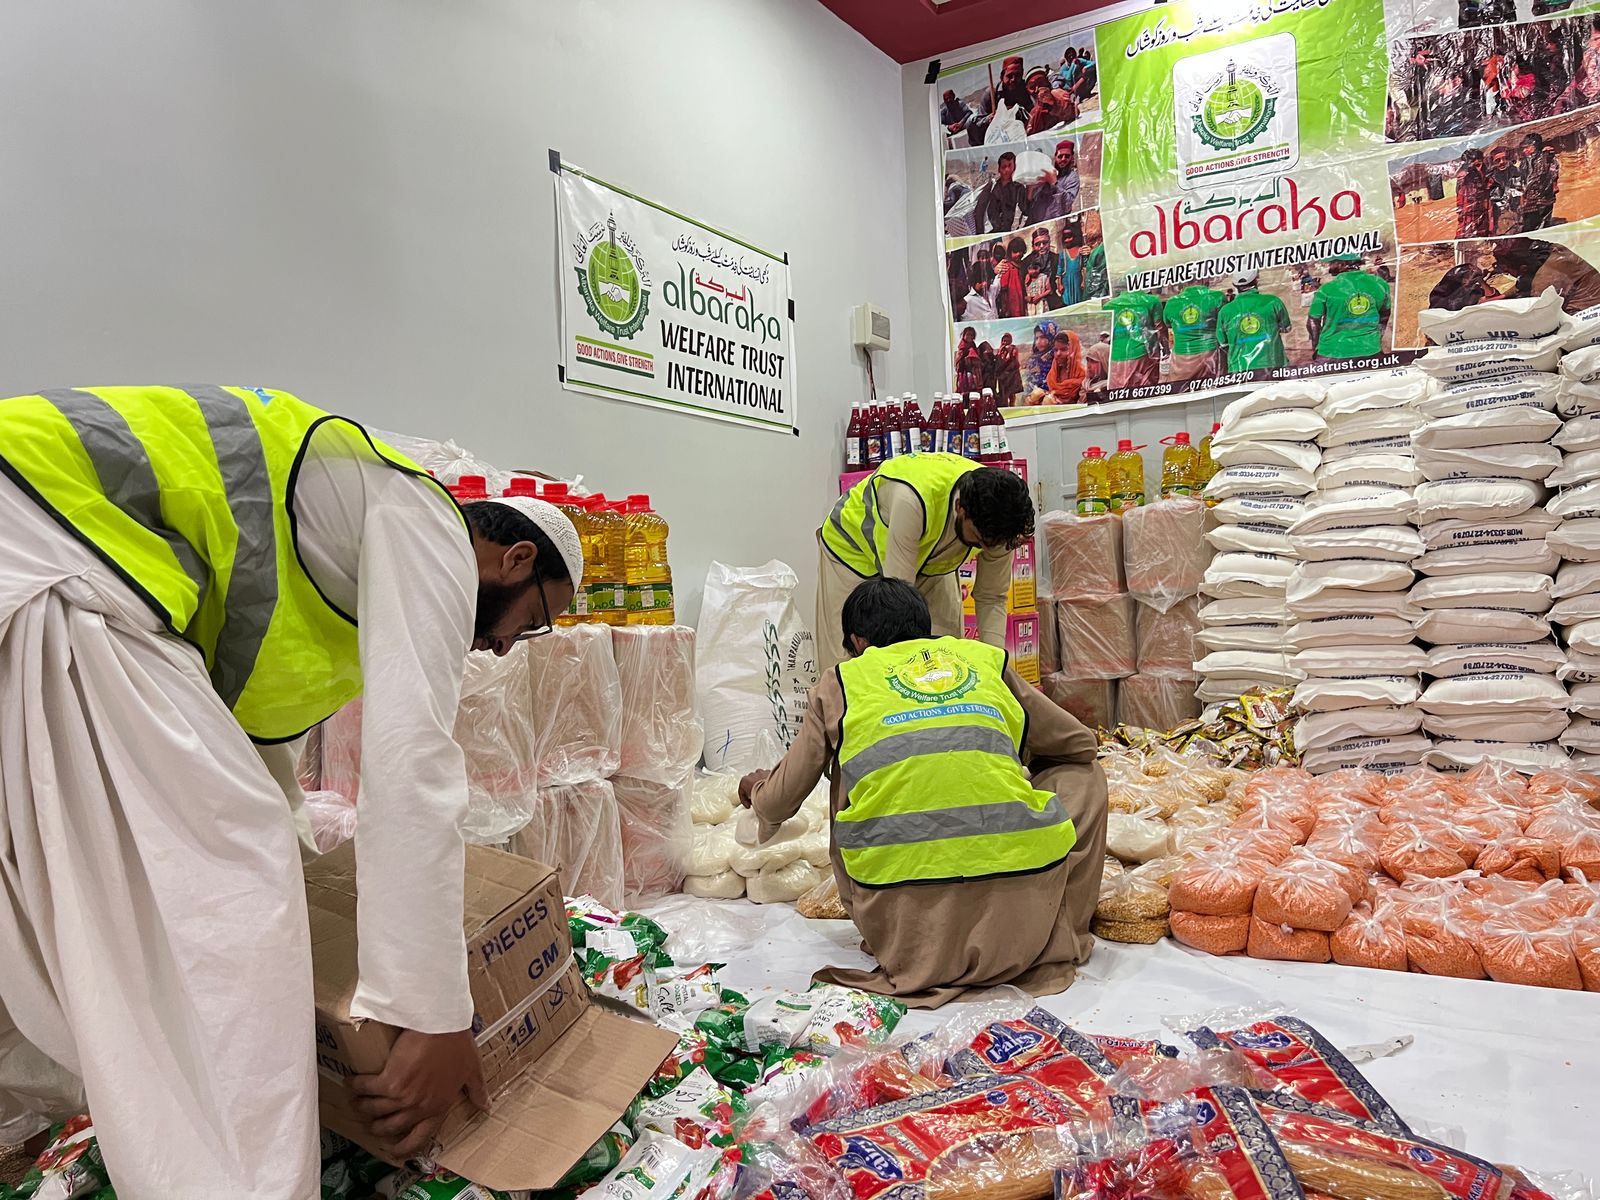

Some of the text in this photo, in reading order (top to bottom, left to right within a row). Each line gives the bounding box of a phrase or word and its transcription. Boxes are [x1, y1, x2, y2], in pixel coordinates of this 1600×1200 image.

[1186, 165, 1204, 176] GOOD
[1253, 147, 1290, 162] STRENGTH
[1129, 177, 1362, 259] albaraka
[1248, 231, 1381, 270] INTERNATIONAL
[662, 261, 782, 344] albaraka
[616, 326, 629, 336] Trust
[661, 320, 785, 379] WELFARE TRUST
[576, 342, 593, 357] GOOD
[628, 355, 654, 372] STRENGTH
[667, 361, 785, 413] INTERNATIONAL
[1109, 354, 1400, 401] 0121 6677399 07404854270 albarakatrust.org.uk
[884, 712, 907, 724] GOOD
[908, 707, 943, 720] ACTIONS
[947, 705, 966, 714] GIVE
[911, 690, 939, 702] Welfare
[940, 690, 960, 701] Trust
[481, 898, 548, 966] PIECES
[528, 941, 560, 980] GM
